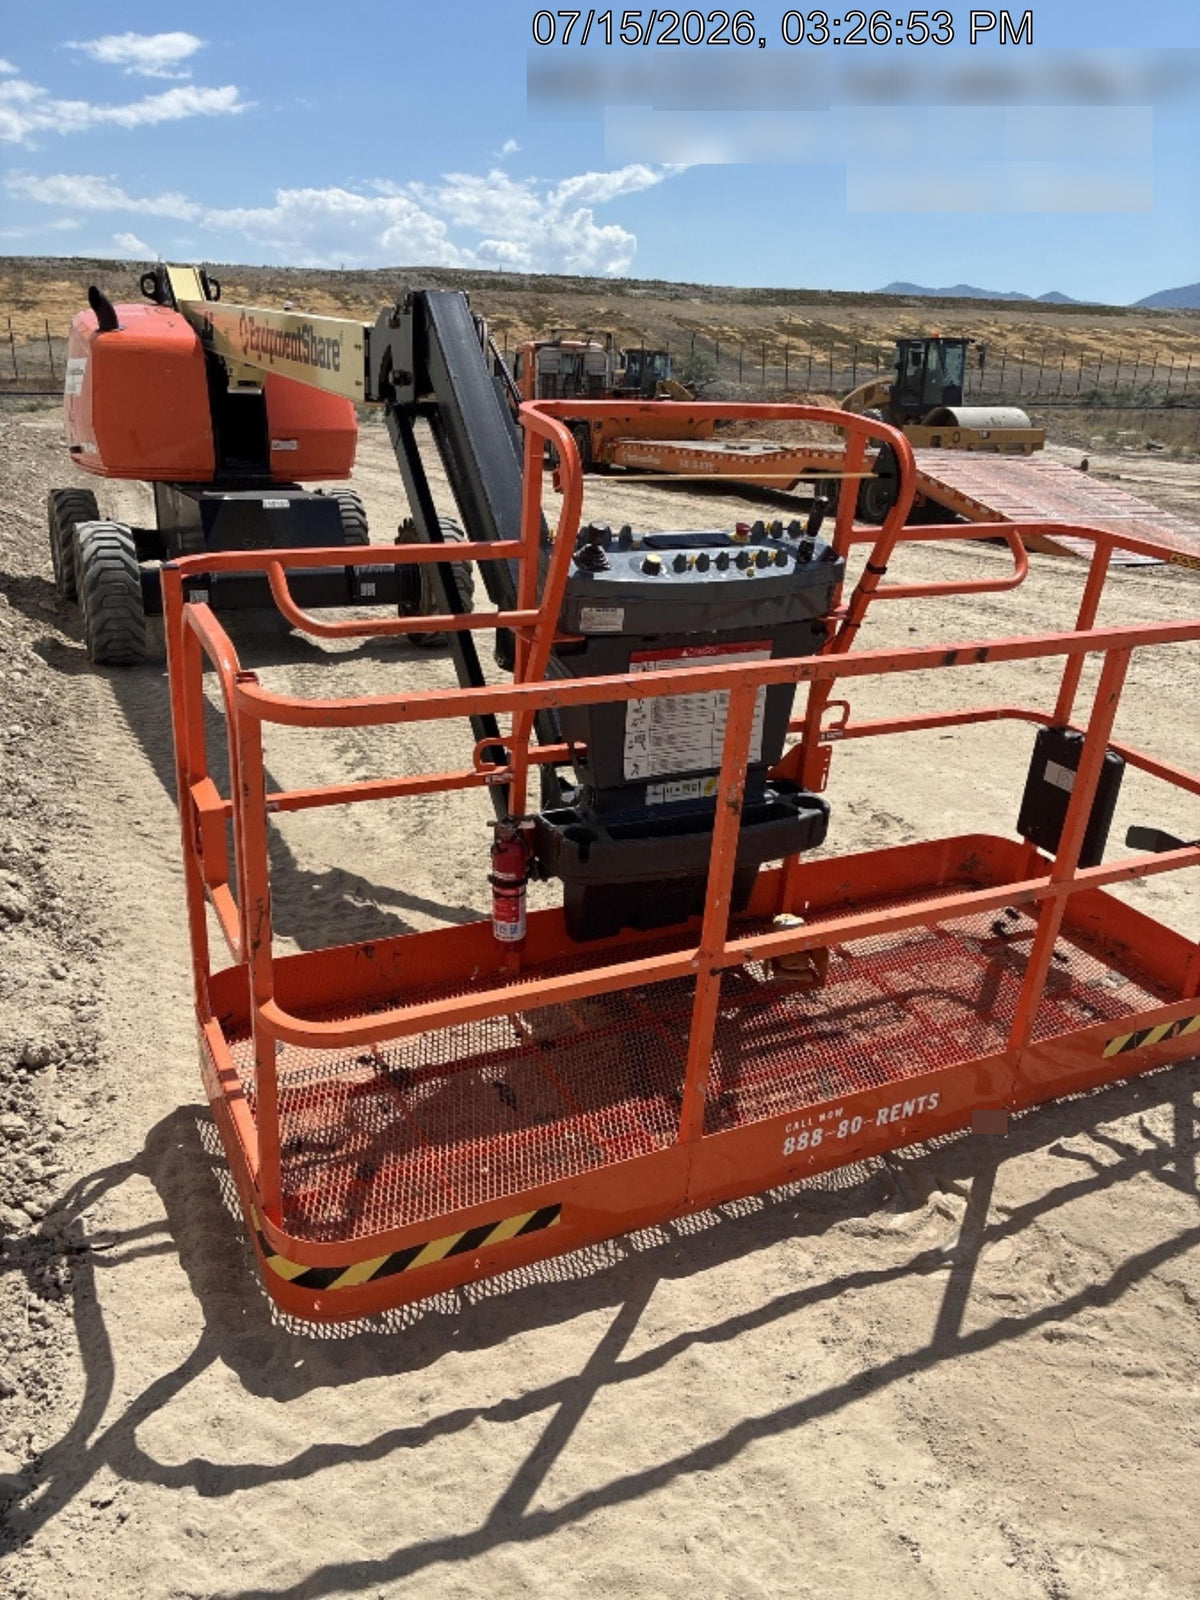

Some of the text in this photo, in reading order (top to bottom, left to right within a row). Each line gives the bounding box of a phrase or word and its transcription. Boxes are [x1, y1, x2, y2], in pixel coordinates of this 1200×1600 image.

[248, 314, 341, 372] EquipmentShare
[782, 1092, 940, 1156] 888-80-RENTS
[785, 1107, 844, 1133] CALL NOW
